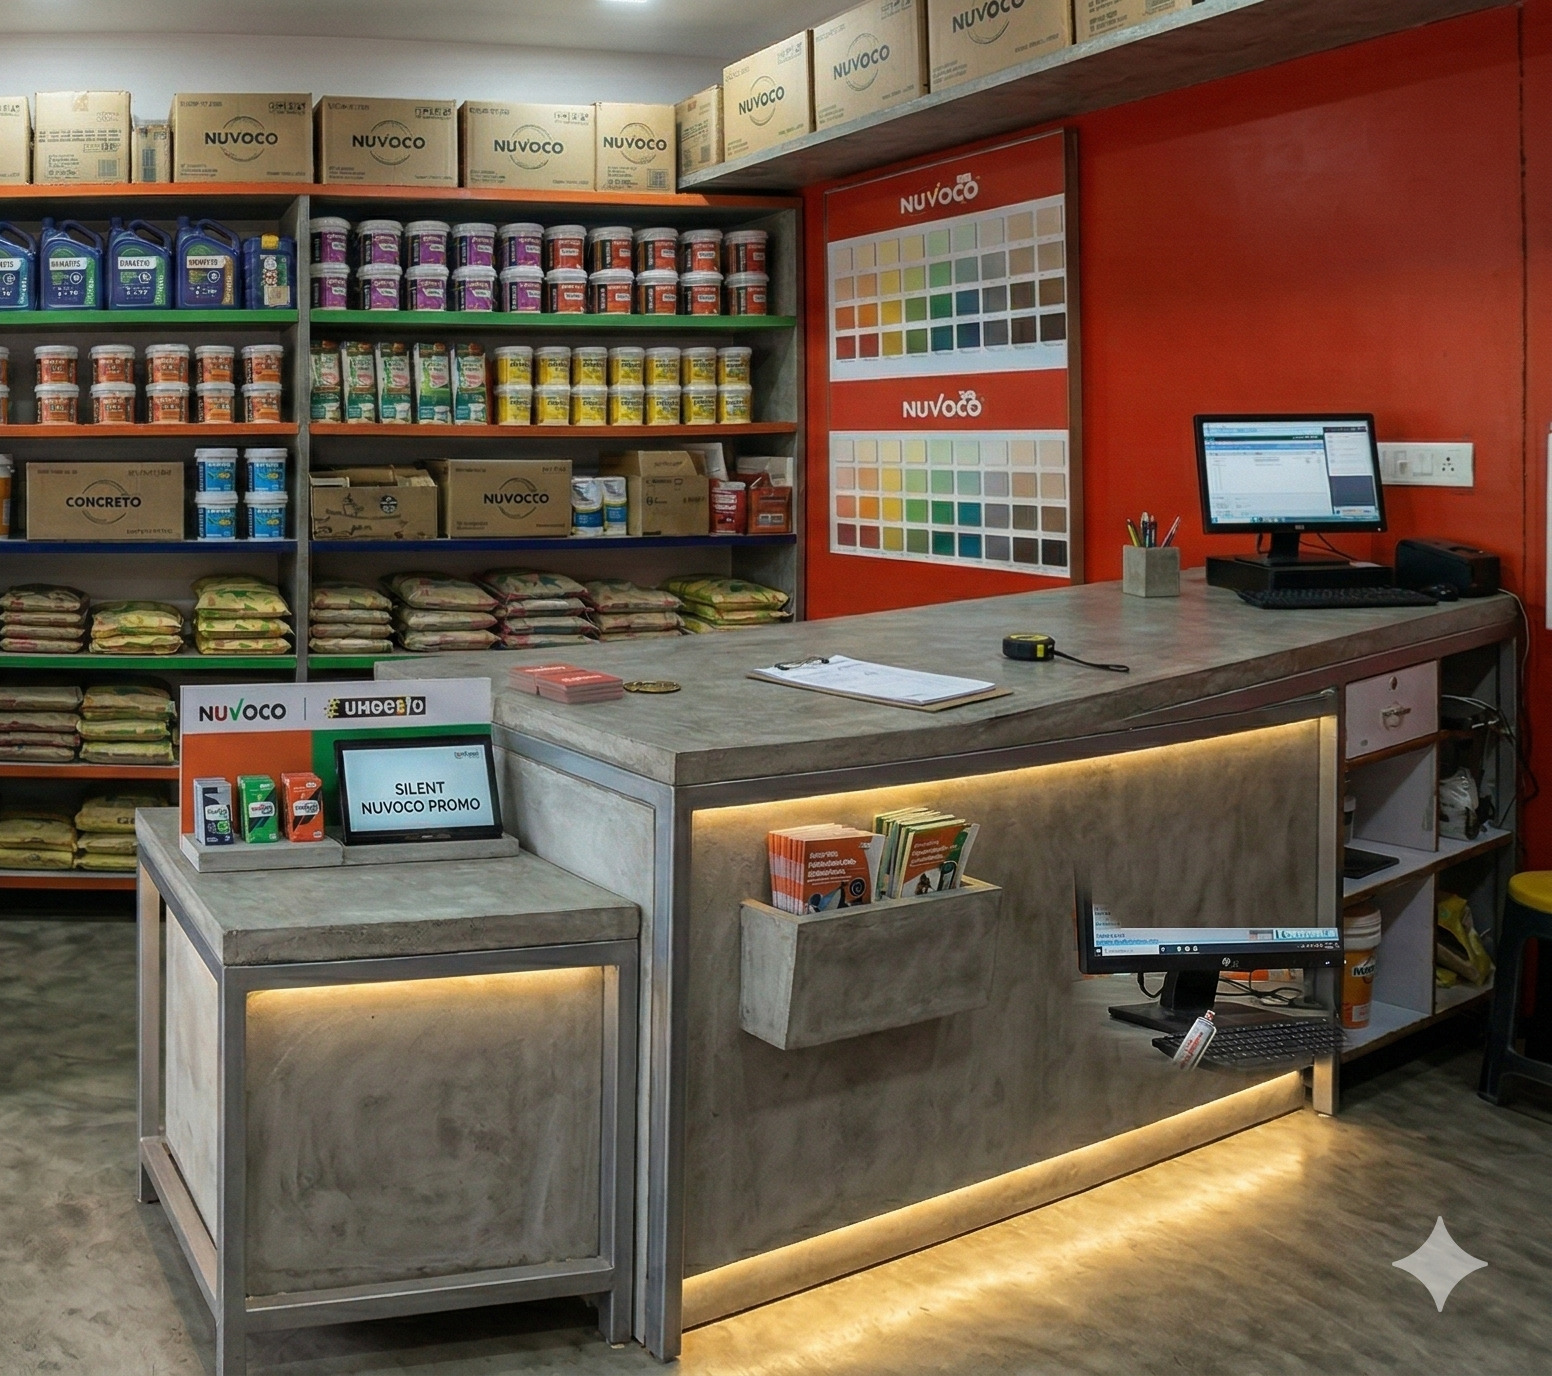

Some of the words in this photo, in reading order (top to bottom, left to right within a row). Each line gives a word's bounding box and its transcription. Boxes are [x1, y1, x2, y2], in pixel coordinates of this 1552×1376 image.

[833, 44, 890, 80] NUVOCO
[738, 86, 785, 115] NUVOCO
[205, 131, 278, 145] NUVOCO
[352, 135, 426, 150] NUVOCO
[603, 136, 667, 151] NUVOCO
[494, 139, 564, 155] NUVOCO
[900, 181, 979, 215] NUVOCO
[903, 393, 982, 418] NUVOCO
[66, 496, 142, 508] CONCRETO
[199, 698, 287, 722] NUVOCO
[395, 781, 445, 796] SILENT
[361, 799, 425, 815] NUVOCO
[429, 797, 480, 813] PROMO
